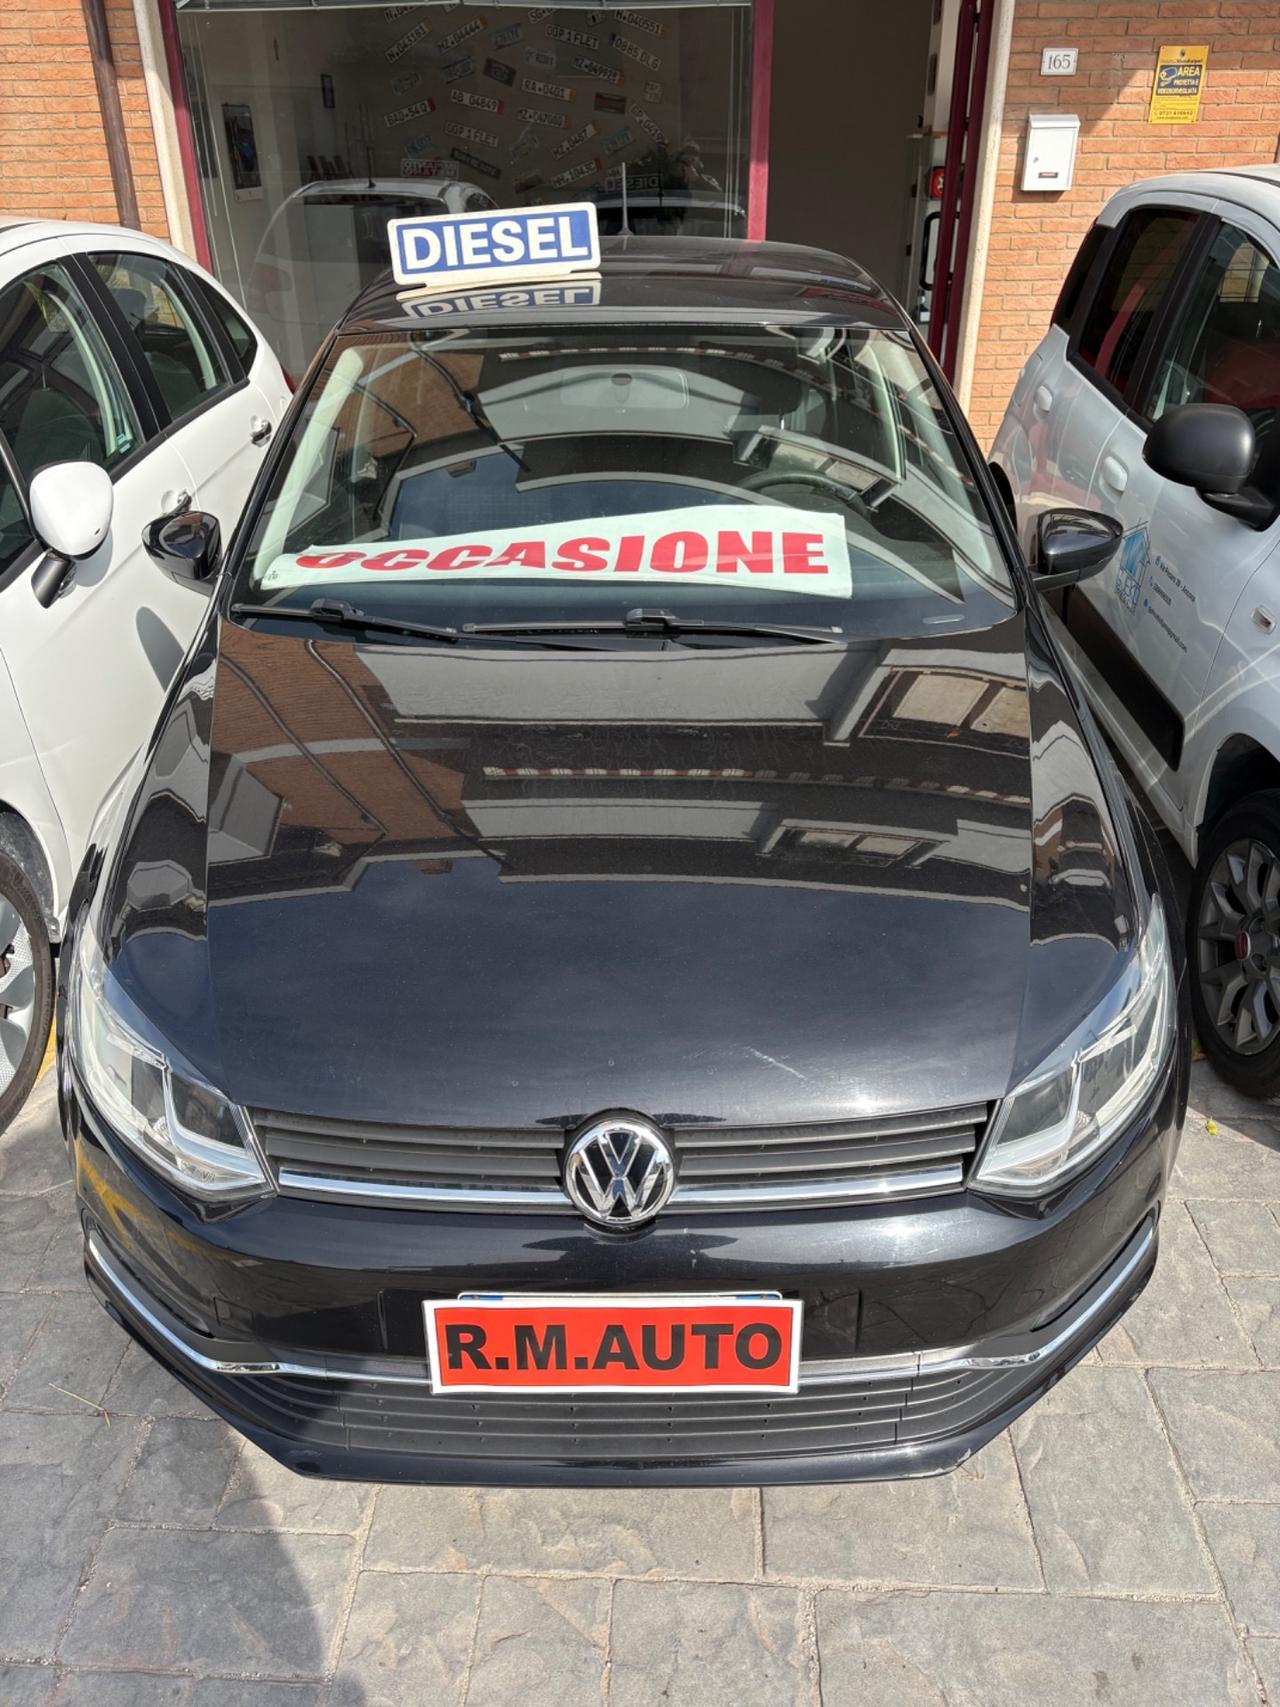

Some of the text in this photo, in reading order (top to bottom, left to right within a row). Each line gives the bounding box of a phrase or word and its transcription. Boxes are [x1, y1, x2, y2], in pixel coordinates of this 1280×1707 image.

[1048, 54, 1071, 70] 165
[1177, 66, 1200, 76] AREA
[402, 216, 589, 270] DIESEL
[295, 529, 829, 574] OCCASIONE
[445, 1322, 782, 1371] R.M.AUTO
